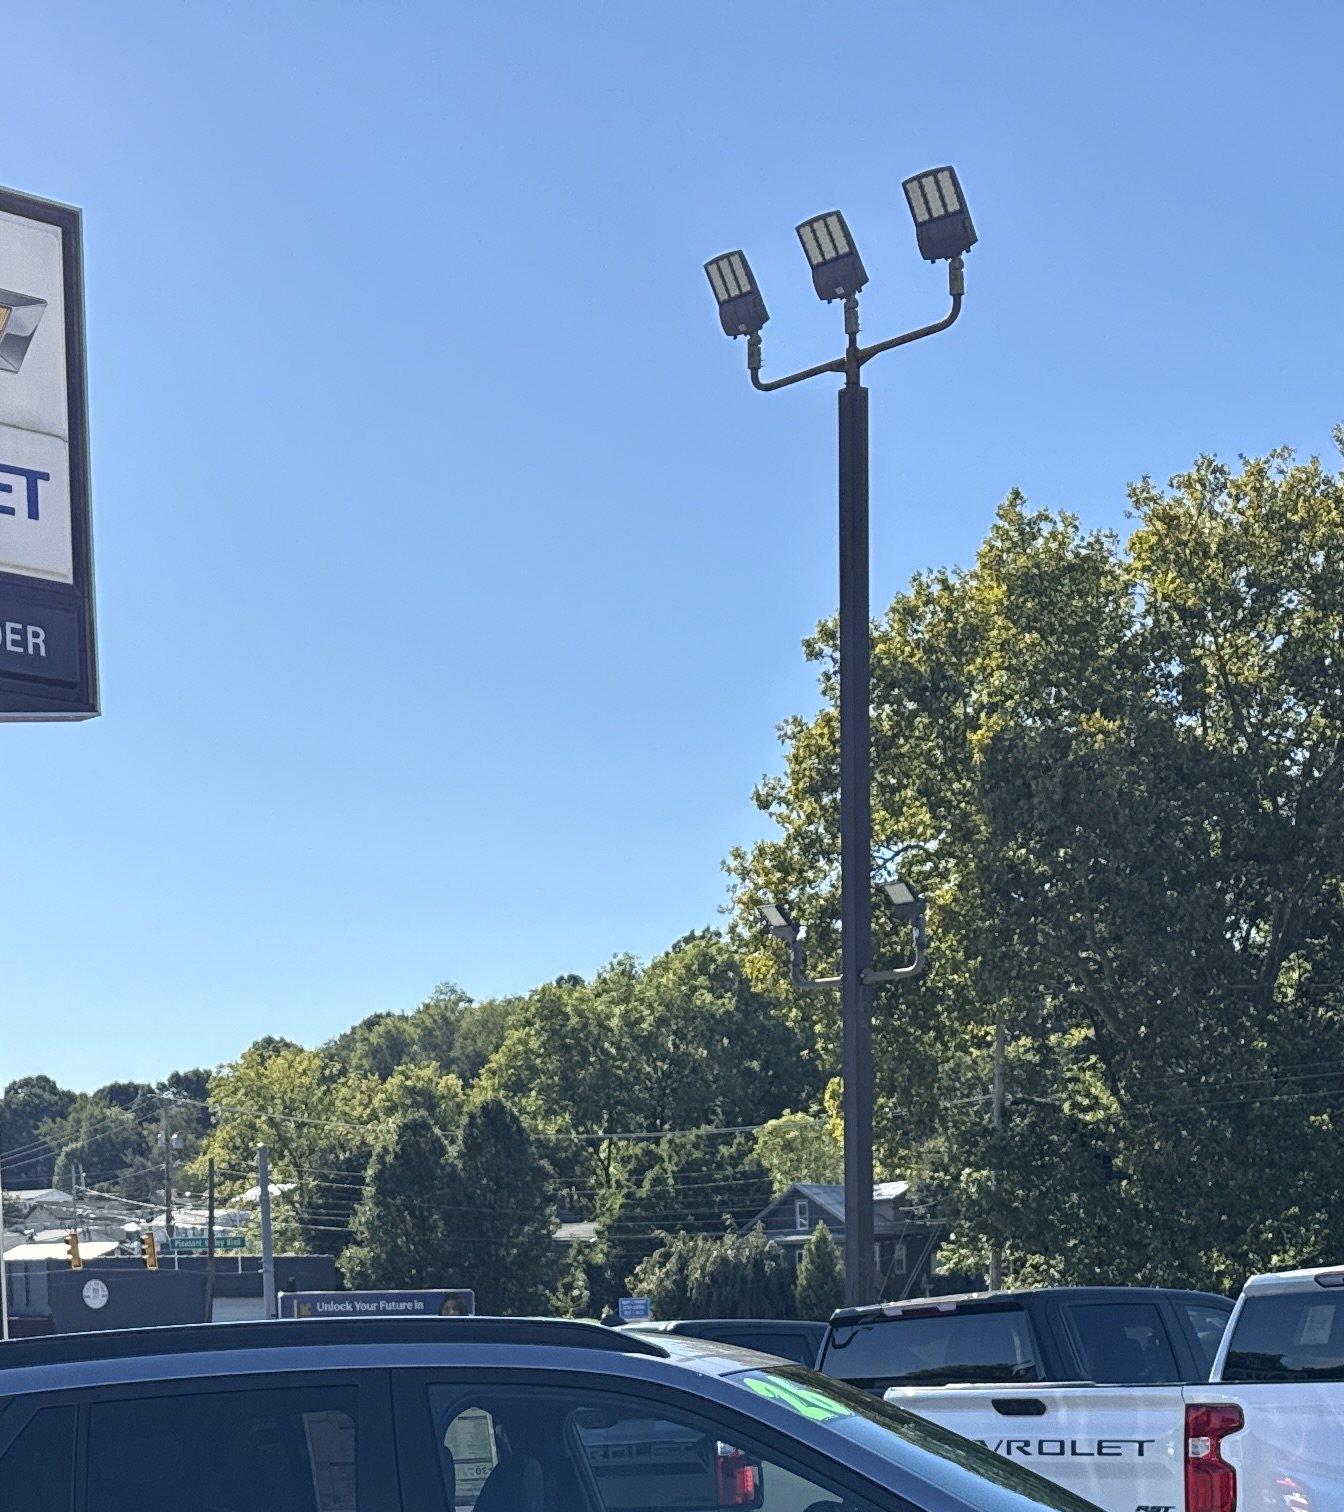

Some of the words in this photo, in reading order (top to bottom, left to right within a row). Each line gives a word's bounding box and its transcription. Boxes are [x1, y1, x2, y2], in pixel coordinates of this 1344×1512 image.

[316, 1301, 353, 1312] Unlock
[354, 1300, 378, 1311] Your
[379, 1300, 414, 1311] Future
[414, 1299, 425, 1310] in
[972, 1439, 1155, 1457] VROLET
[1135, 1505, 1176, 1512] RST
